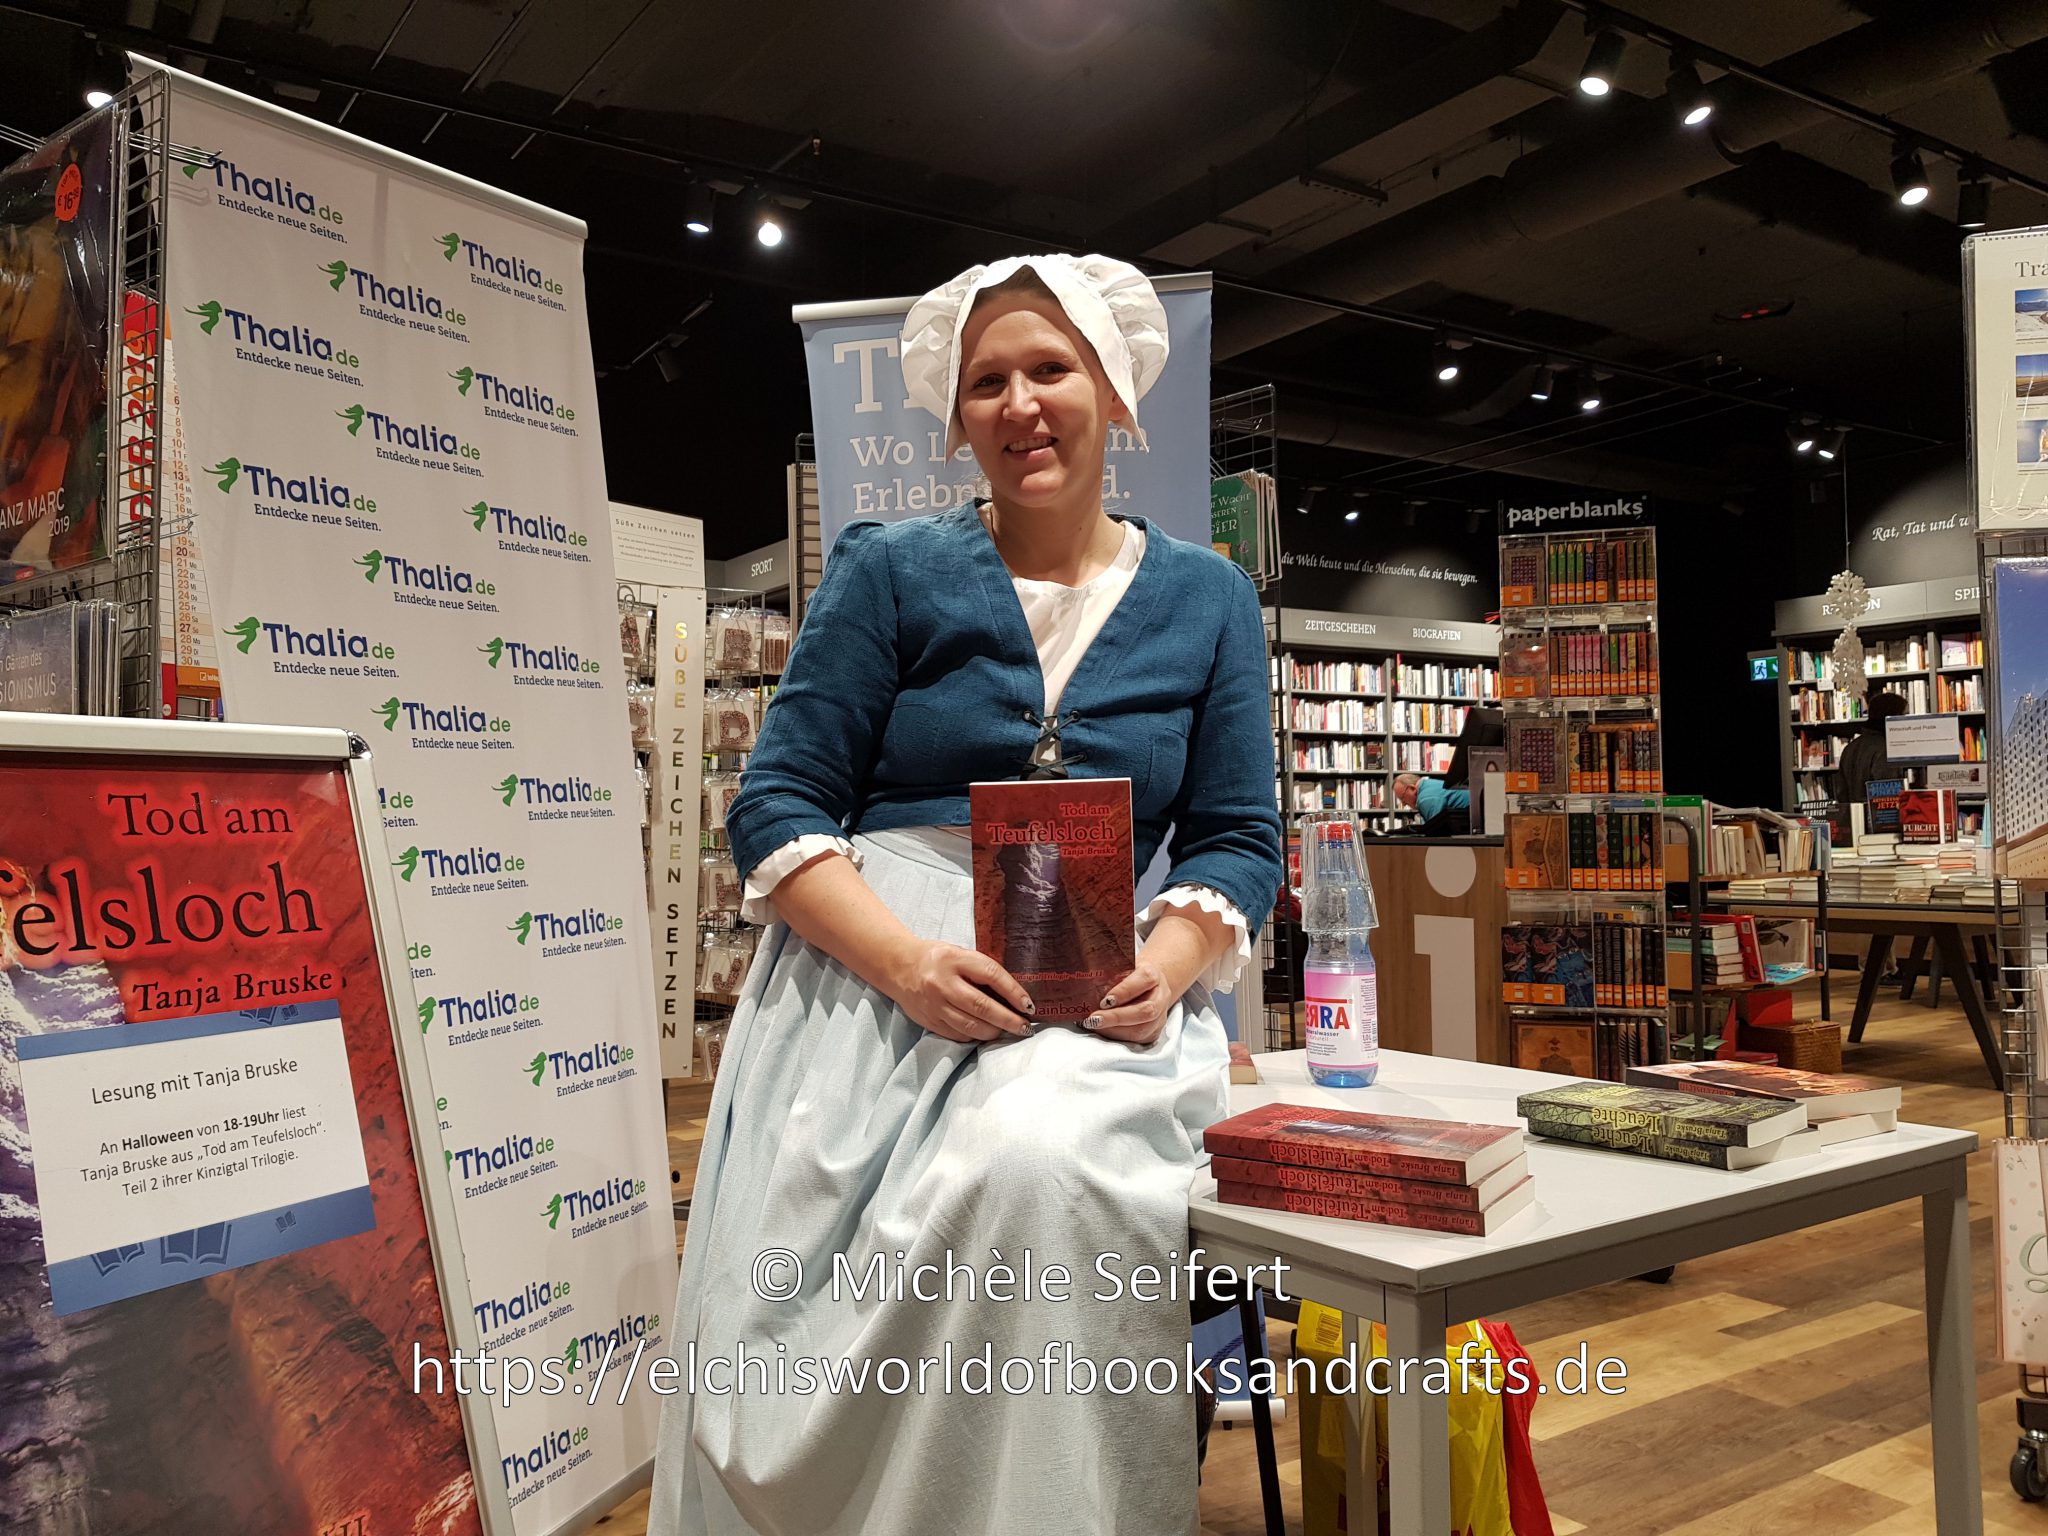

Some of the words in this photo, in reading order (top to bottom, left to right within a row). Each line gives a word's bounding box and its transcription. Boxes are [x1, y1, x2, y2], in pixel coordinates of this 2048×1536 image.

[217, 194, 274, 220] Entdecke
[277, 214, 307, 230] neue
[310, 223, 348, 244] Seiten.
[470, 273, 511, 294] Entdecke
[513, 289, 535, 301] neue
[538, 294, 567, 312] Seiten.
[850, 433, 914, 467] Wo
[28, 487, 65, 522] MARC
[1507, 499, 1643, 528] paperblanks
[48, 515, 70, 538] 2019
[254, 503, 308, 522] Entdecke
[312, 514, 342, 526] neue
[345, 516, 382, 532] Seiten.
[638, 522, 667, 533] Zeichen
[1872, 527, 1899, 541] Rat,
[1902, 521, 1926, 536] Tat
[1930, 513, 1957, 531] und
[176, 547, 188, 556] 20
[498, 540, 539, 555] Entdecke
[542, 546, 562, 558] neue
[563, 550, 591, 563] Seiten.
[751, 558, 773, 577] SPORT
[1281, 552, 1294, 565] die
[1296, 553, 1318, 567] Welt
[1319, 555, 1342, 570] heute
[1344, 560, 1361, 572] und
[1361, 560, 1374, 573] die
[1418, 565, 1431, 579] die
[1431, 568, 1442, 580] sie
[178, 602, 190, 611] 25
[179, 623, 191, 633] 27
[1304, 619, 1376, 635] ZEITGESCHEHEN
[1412, 627, 1462, 641] BIOGRAFIEN
[181, 656, 192, 665] 30
[273, 661, 326, 675] Entdecke
[329, 666, 360, 676] neue
[363, 665, 400, 678] Seiten.
[107, 792, 208, 837] Tod
[225, 804, 293, 835] am
[1061, 803, 1087, 816] Tod
[1090, 805, 1110, 815] am
[987, 820, 1114, 843] Teufelsloch
[1903, 823, 1938, 832] FURCHT
[1062, 848, 1084, 856] Tanja
[1087, 847, 1116, 855] Bruske
[431, 885, 471, 897] Entdecke
[473, 882, 495, 892] neue
[497, 878, 529, 890] Seiten.
[542, 944, 582, 958] Entdecke
[584, 941, 603, 951] neue
[603, 936, 627, 948] Seiten.
[133, 979, 220, 1014] Tanja
[233, 965, 333, 1000] Bruske
[91, 1080, 157, 1105] Lesung
[161, 1074, 191, 1094] mit
[193, 1067, 241, 1089] Tanja
[244, 1057, 298, 1080] Bruske
[99, 1141, 119, 1156] An
[121, 1127, 194, 1152] Halloween
[197, 1122, 220, 1137] von
[223, 1110, 280, 1132] 18-19Uhr
[282, 1105, 307, 1120] liest
[1593, 1108, 1660, 1134] Leuchte
[1676, 1124, 1703, 1136] Bruske
[1593, 1128, 1651, 1152] Leuchte
[1705, 1127, 1727, 1139] Tanja
[80, 1166, 119, 1183] Tanja
[122, 1155, 168, 1175] Bruske
[171, 1150, 194, 1164] aus
[229, 1139, 249, 1152] am
[1271, 1144, 1351, 1169] Teufelsloch
[1354, 1154, 1369, 1163] am
[1371, 1156, 1390, 1167] Tod
[121, 1180, 147, 1197] Teil
[150, 1177, 159, 1191] 2
[162, 1171, 193, 1189] ihrer
[196, 1159, 249, 1181] Kinzigtal
[251, 1149, 299, 1171] Trilogie.
[1400, 1161, 1430, 1173] Bruske
[1433, 1165, 1458, 1177] Tanja
[464, 1178, 508, 1199] Entdecke
[509, 1170, 529, 1185] neue
[530, 1159, 559, 1176] Seiten.
[1279, 1169, 1363, 1195] Teufelsloch
[1365, 1180, 1379, 1189] am
[1381, 1182, 1400, 1193] Tod
[1412, 1188, 1442, 1199] Bruske
[1445, 1192, 1470, 1204] Tanja
[1286, 1194, 1369, 1220] Teufelsloch
[1371, 1205, 1385, 1214] am
[1387, 1207, 1408, 1219] Tod
[1417, 1214, 1448, 1225] Bruske
[1450, 1217, 1475, 1229] Tanja
